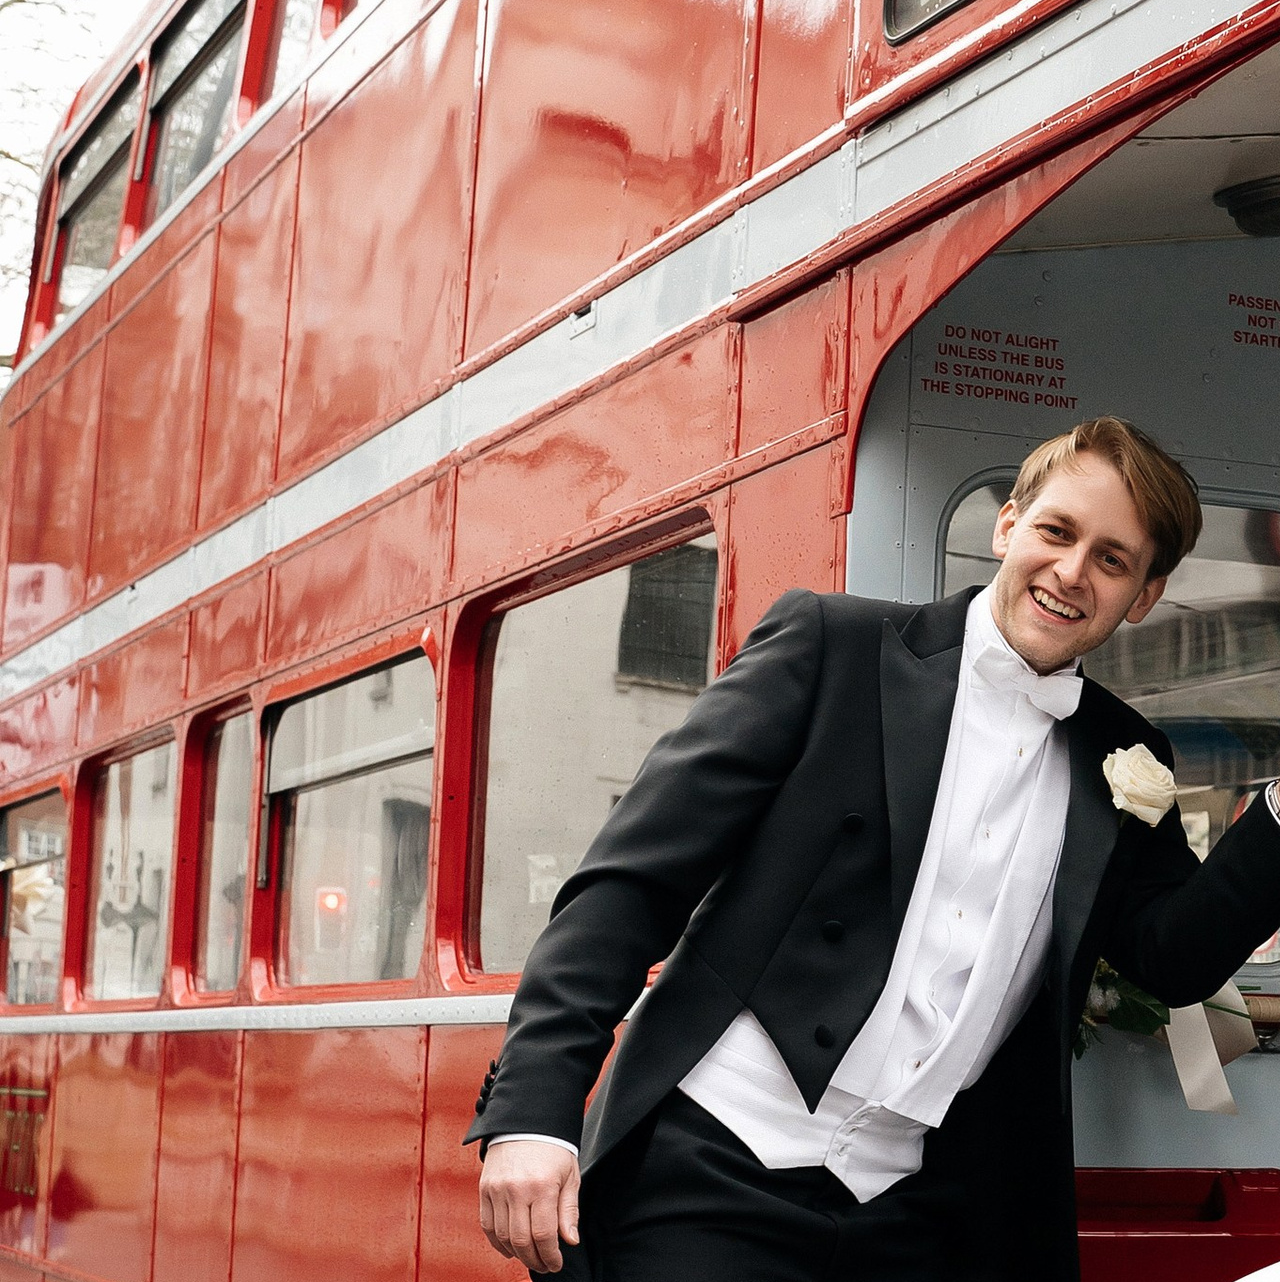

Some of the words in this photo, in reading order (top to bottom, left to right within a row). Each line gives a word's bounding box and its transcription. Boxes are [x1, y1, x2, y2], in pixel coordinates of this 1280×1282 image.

[1248, 314, 1277, 329] NOT
[945, 325, 967, 339] DO
[971, 328, 1002, 344] NOT
[1005, 333, 1060, 351] ALIGHT
[938, 342, 997, 362] UNLESS
[1001, 351, 1030, 366] THE
[1034, 355, 1065, 370] BUS
[935, 361, 948, 374] IS
[953, 363, 1045, 387] STATIONARY
[1048, 376, 1066, 389] AT
[921, 378, 950, 393] THE
[955, 383, 1029, 404] STOPPING
[1034, 393, 1078, 409] POINT
